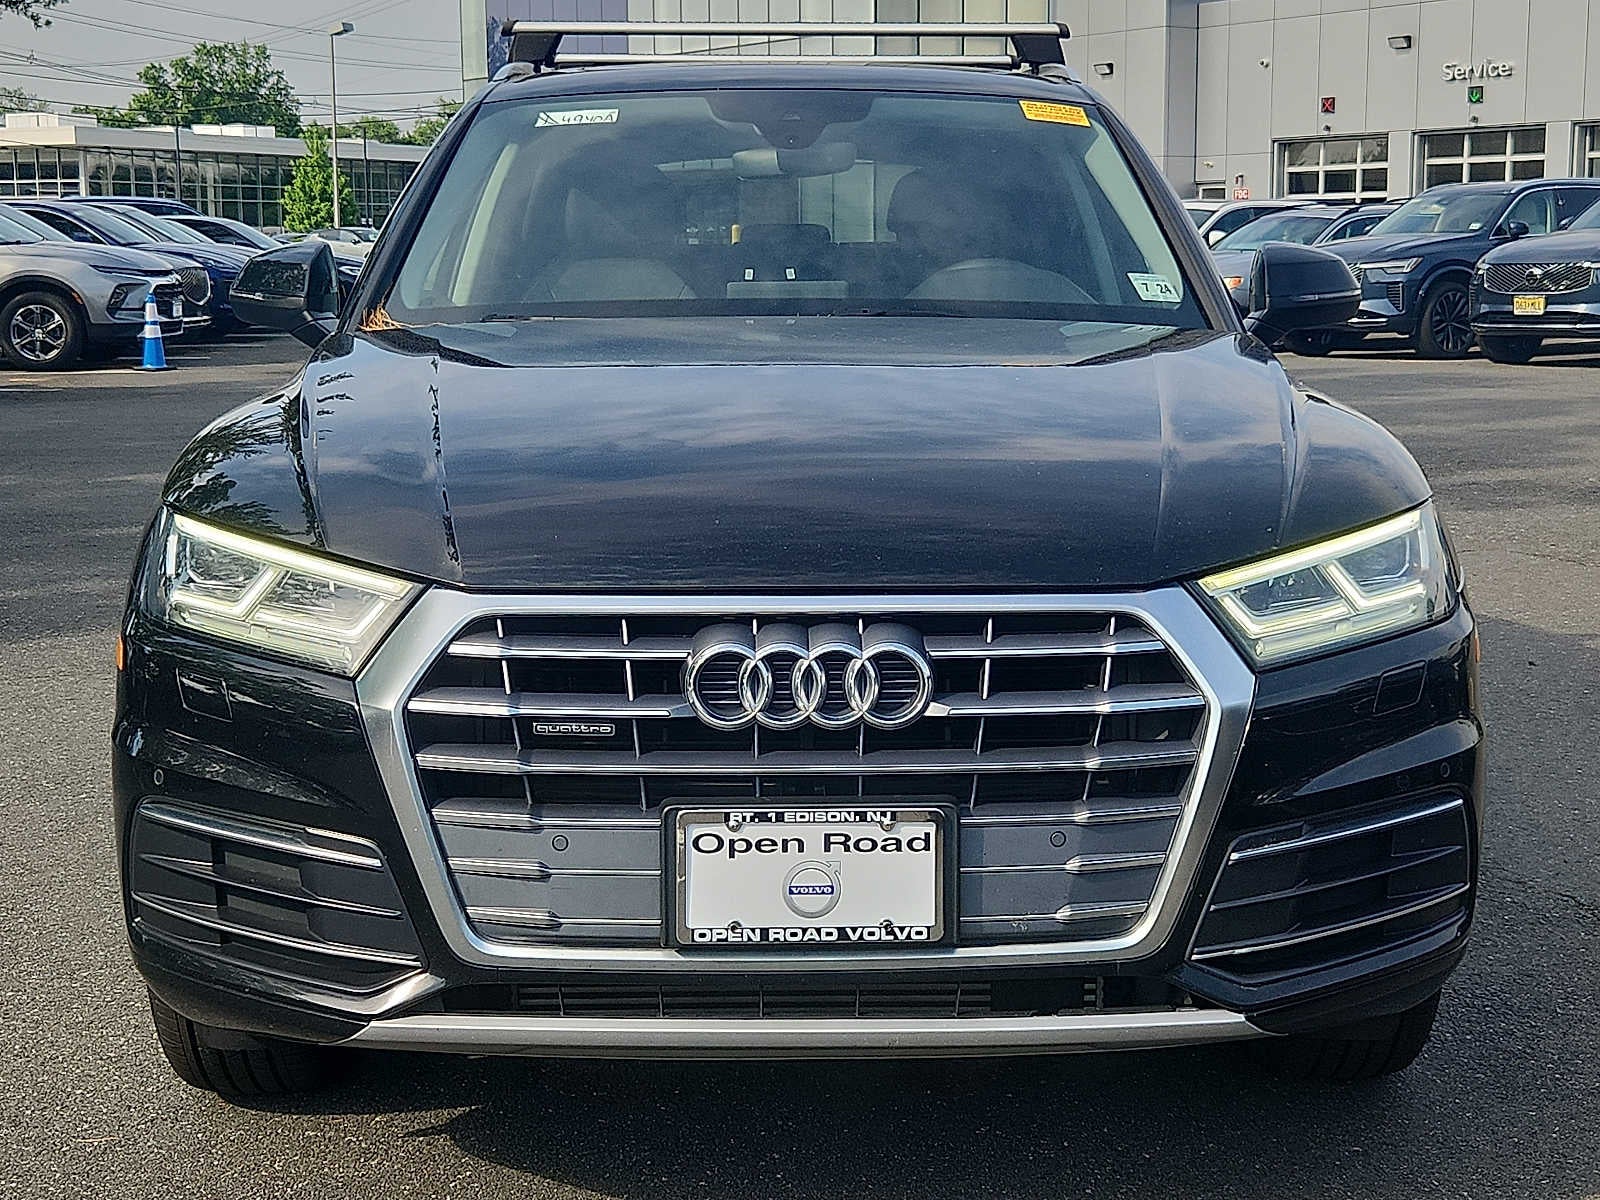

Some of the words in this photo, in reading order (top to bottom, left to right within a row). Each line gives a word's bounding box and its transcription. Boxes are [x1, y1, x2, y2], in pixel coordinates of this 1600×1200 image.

[1441, 58, 1512, 81] Service
[536, 724, 612, 734] quattro
[729, 811, 759, 823] RT.
[768, 812, 777, 823] 1
[867, 811, 891, 824] NJ
[691, 832, 805, 859] Open
[823, 831, 931, 854] Road
[790, 886, 832, 894] VOLVO
[693, 928, 761, 943] OPEN
[768, 927, 838, 942] ROAD
[846, 926, 929, 941] VOLVO
